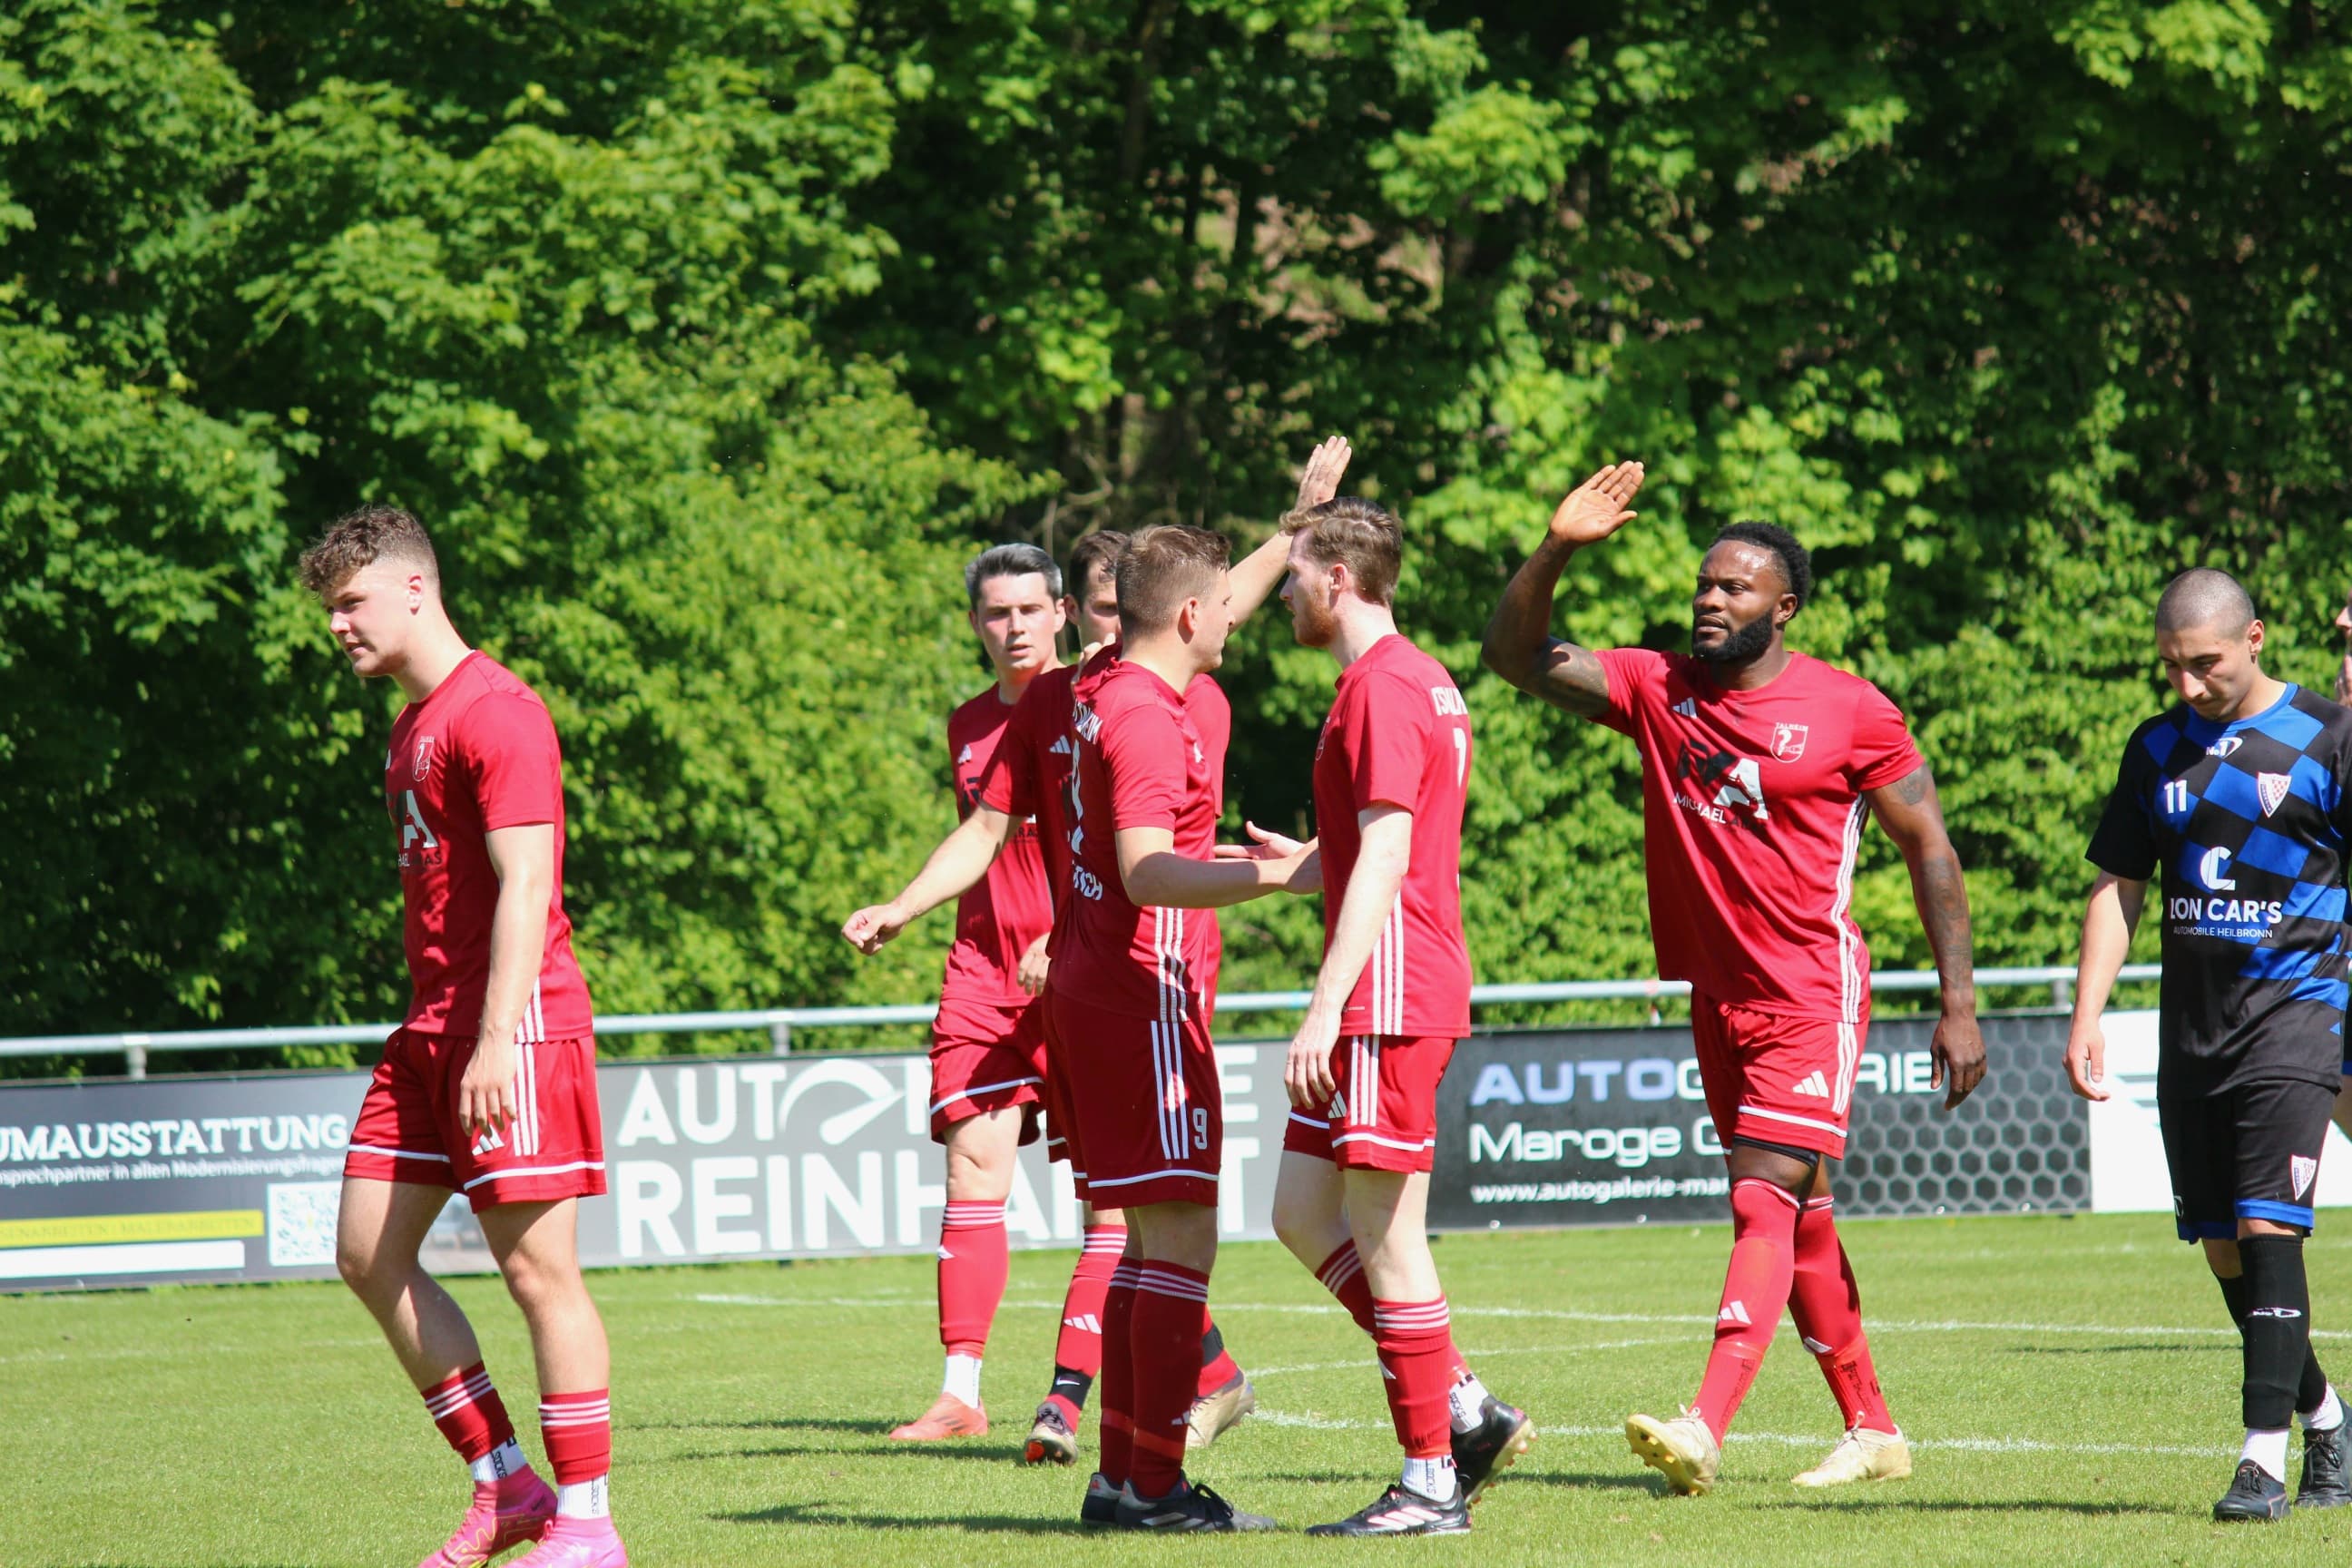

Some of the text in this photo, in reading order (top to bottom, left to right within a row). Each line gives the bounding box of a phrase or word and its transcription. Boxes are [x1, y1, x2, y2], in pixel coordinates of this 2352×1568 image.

[2164, 779, 2188, 814] 11
[2207, 898, 2283, 924] CAR'S
[2173, 926, 2273, 938] AUTOMOBILE HEILBRONN
[1470, 1052, 1942, 1106] AUTOGRIE
[1192, 1108, 1208, 1150] 9
[1468, 1122, 1682, 1168] Maroge
[113, 1161, 130, 1180] in
[131, 1160, 171, 1179] allen
[616, 1137, 1260, 1258] REINHAT
